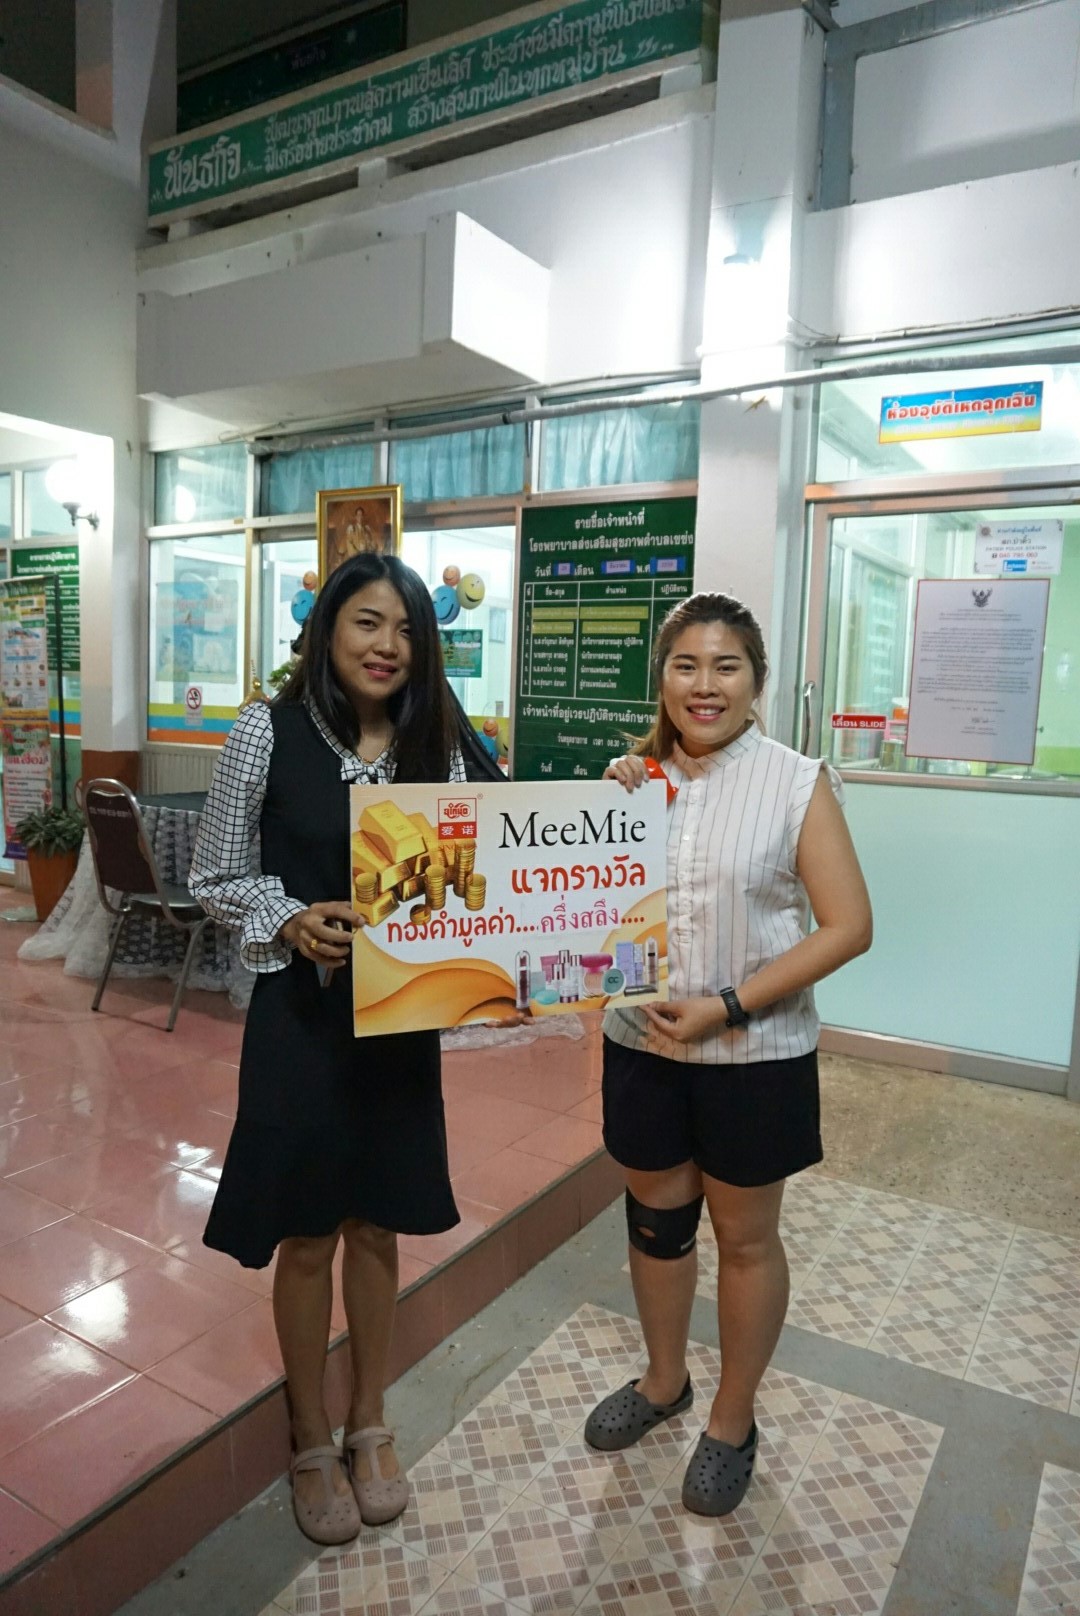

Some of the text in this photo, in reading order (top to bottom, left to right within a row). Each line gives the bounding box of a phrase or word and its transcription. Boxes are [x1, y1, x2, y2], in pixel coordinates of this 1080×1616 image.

[164, 134, 241, 199] พันธกิจ
[860, 720, 886, 728] SLIDE
[498, 809, 647, 849] MeeMie
[511, 854, 646, 894] แจกรางวัล
